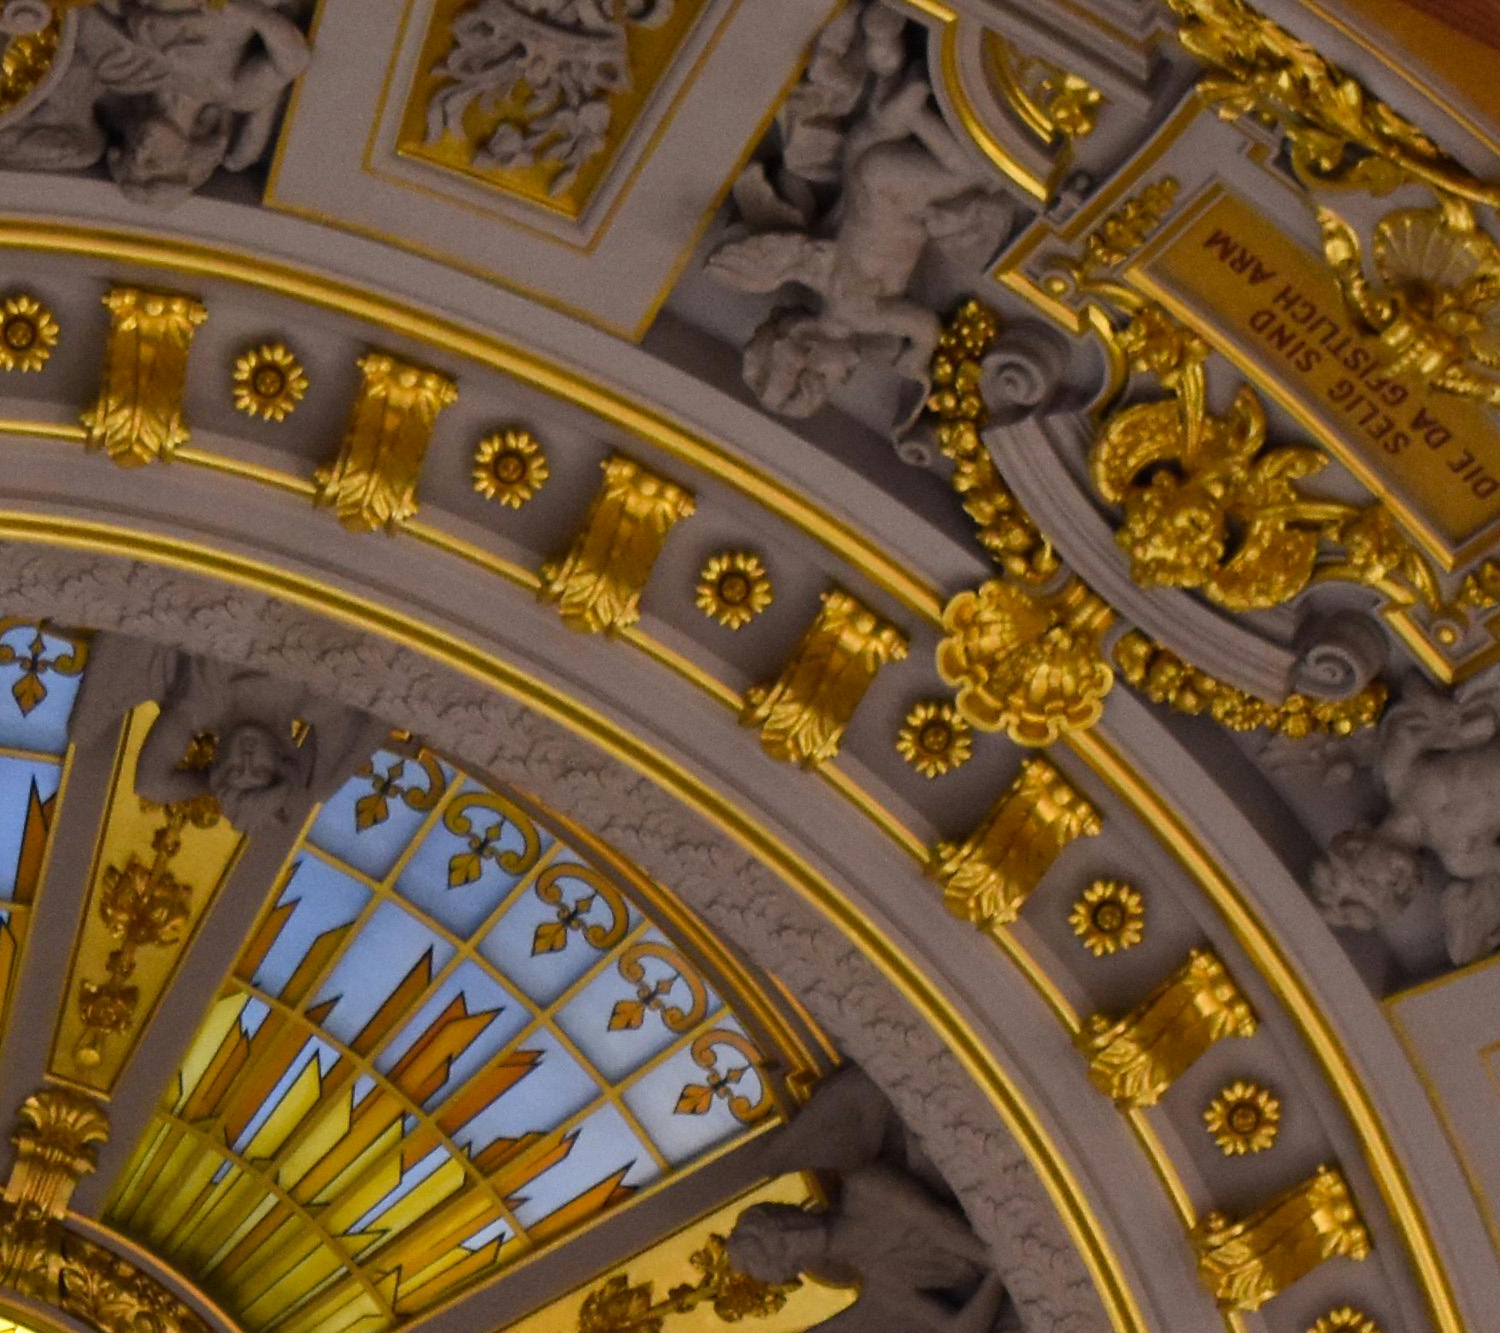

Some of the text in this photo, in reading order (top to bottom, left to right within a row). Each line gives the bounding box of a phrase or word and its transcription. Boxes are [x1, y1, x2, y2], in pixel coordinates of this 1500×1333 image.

[1203, 228, 1277, 286] ARM
[1249, 308, 1410, 455] SELIG SIND
[1411, 407, 1453, 450] DA
[1447, 449, 1499, 499] DIE
